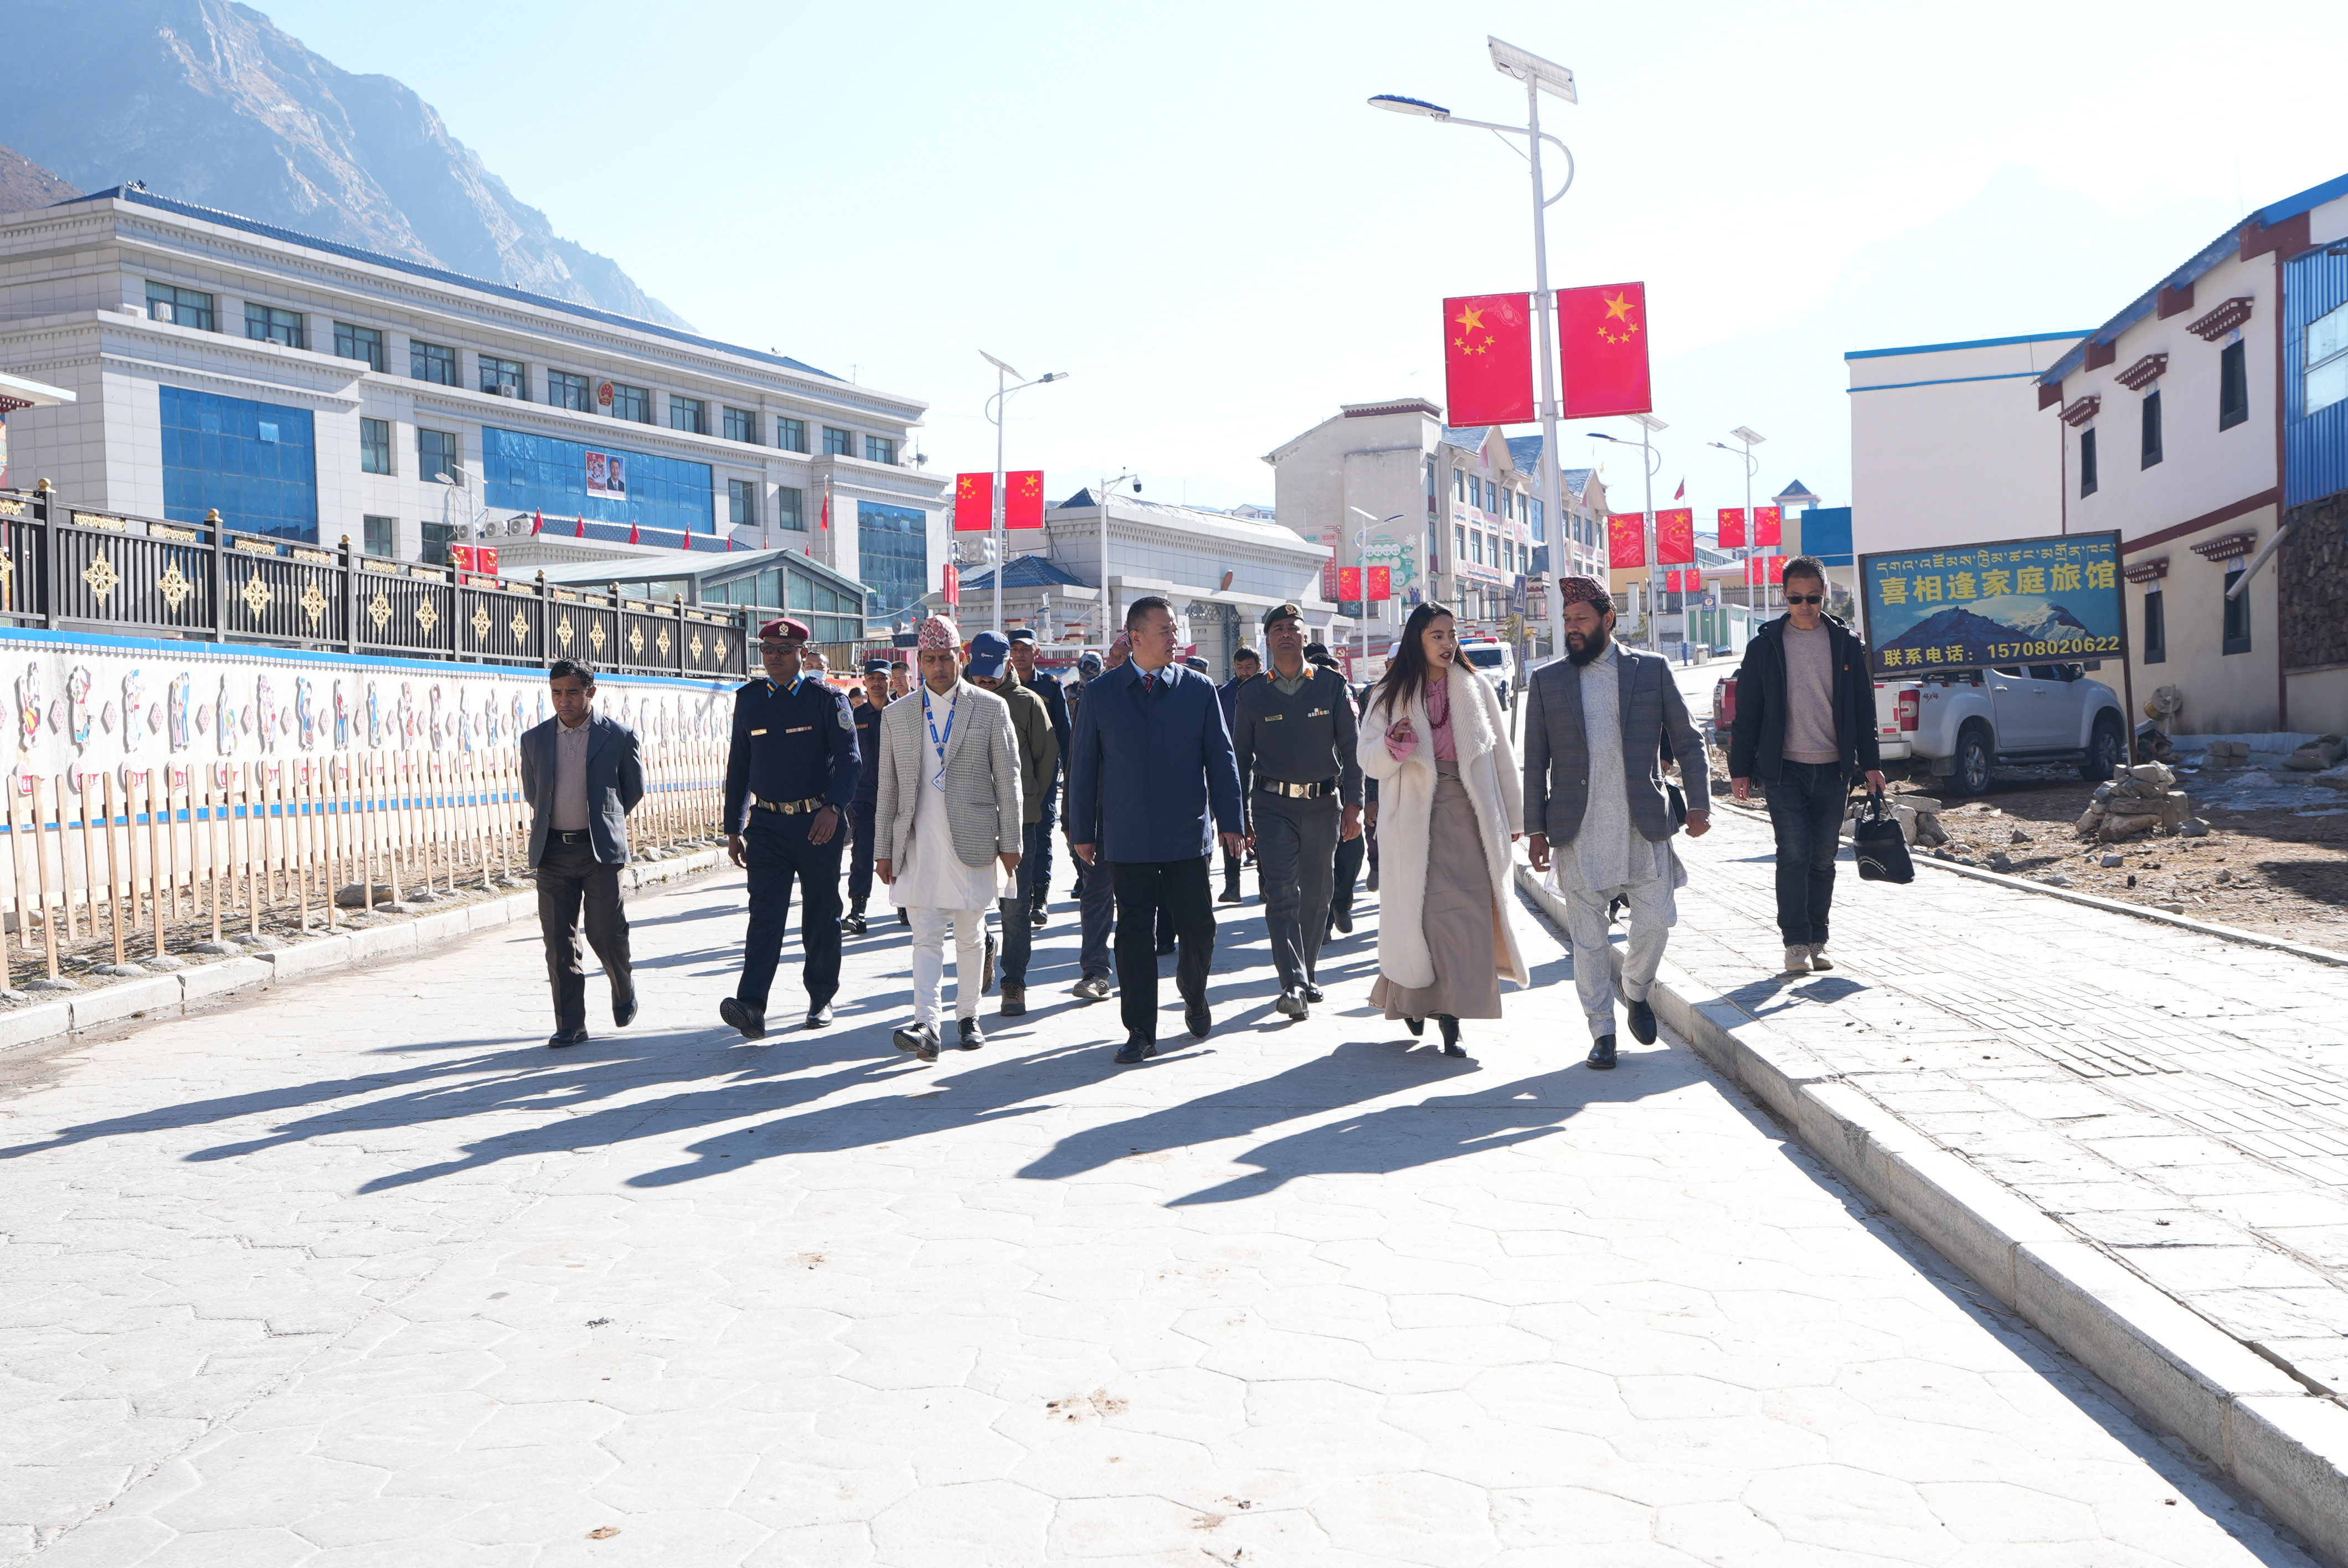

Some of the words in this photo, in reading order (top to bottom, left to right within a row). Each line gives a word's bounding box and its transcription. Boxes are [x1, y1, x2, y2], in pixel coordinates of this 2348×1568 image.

[1879, 560, 2115, 605] 喜相逢家庭旅馆
[1987, 636, 2120, 658] 15708020622
